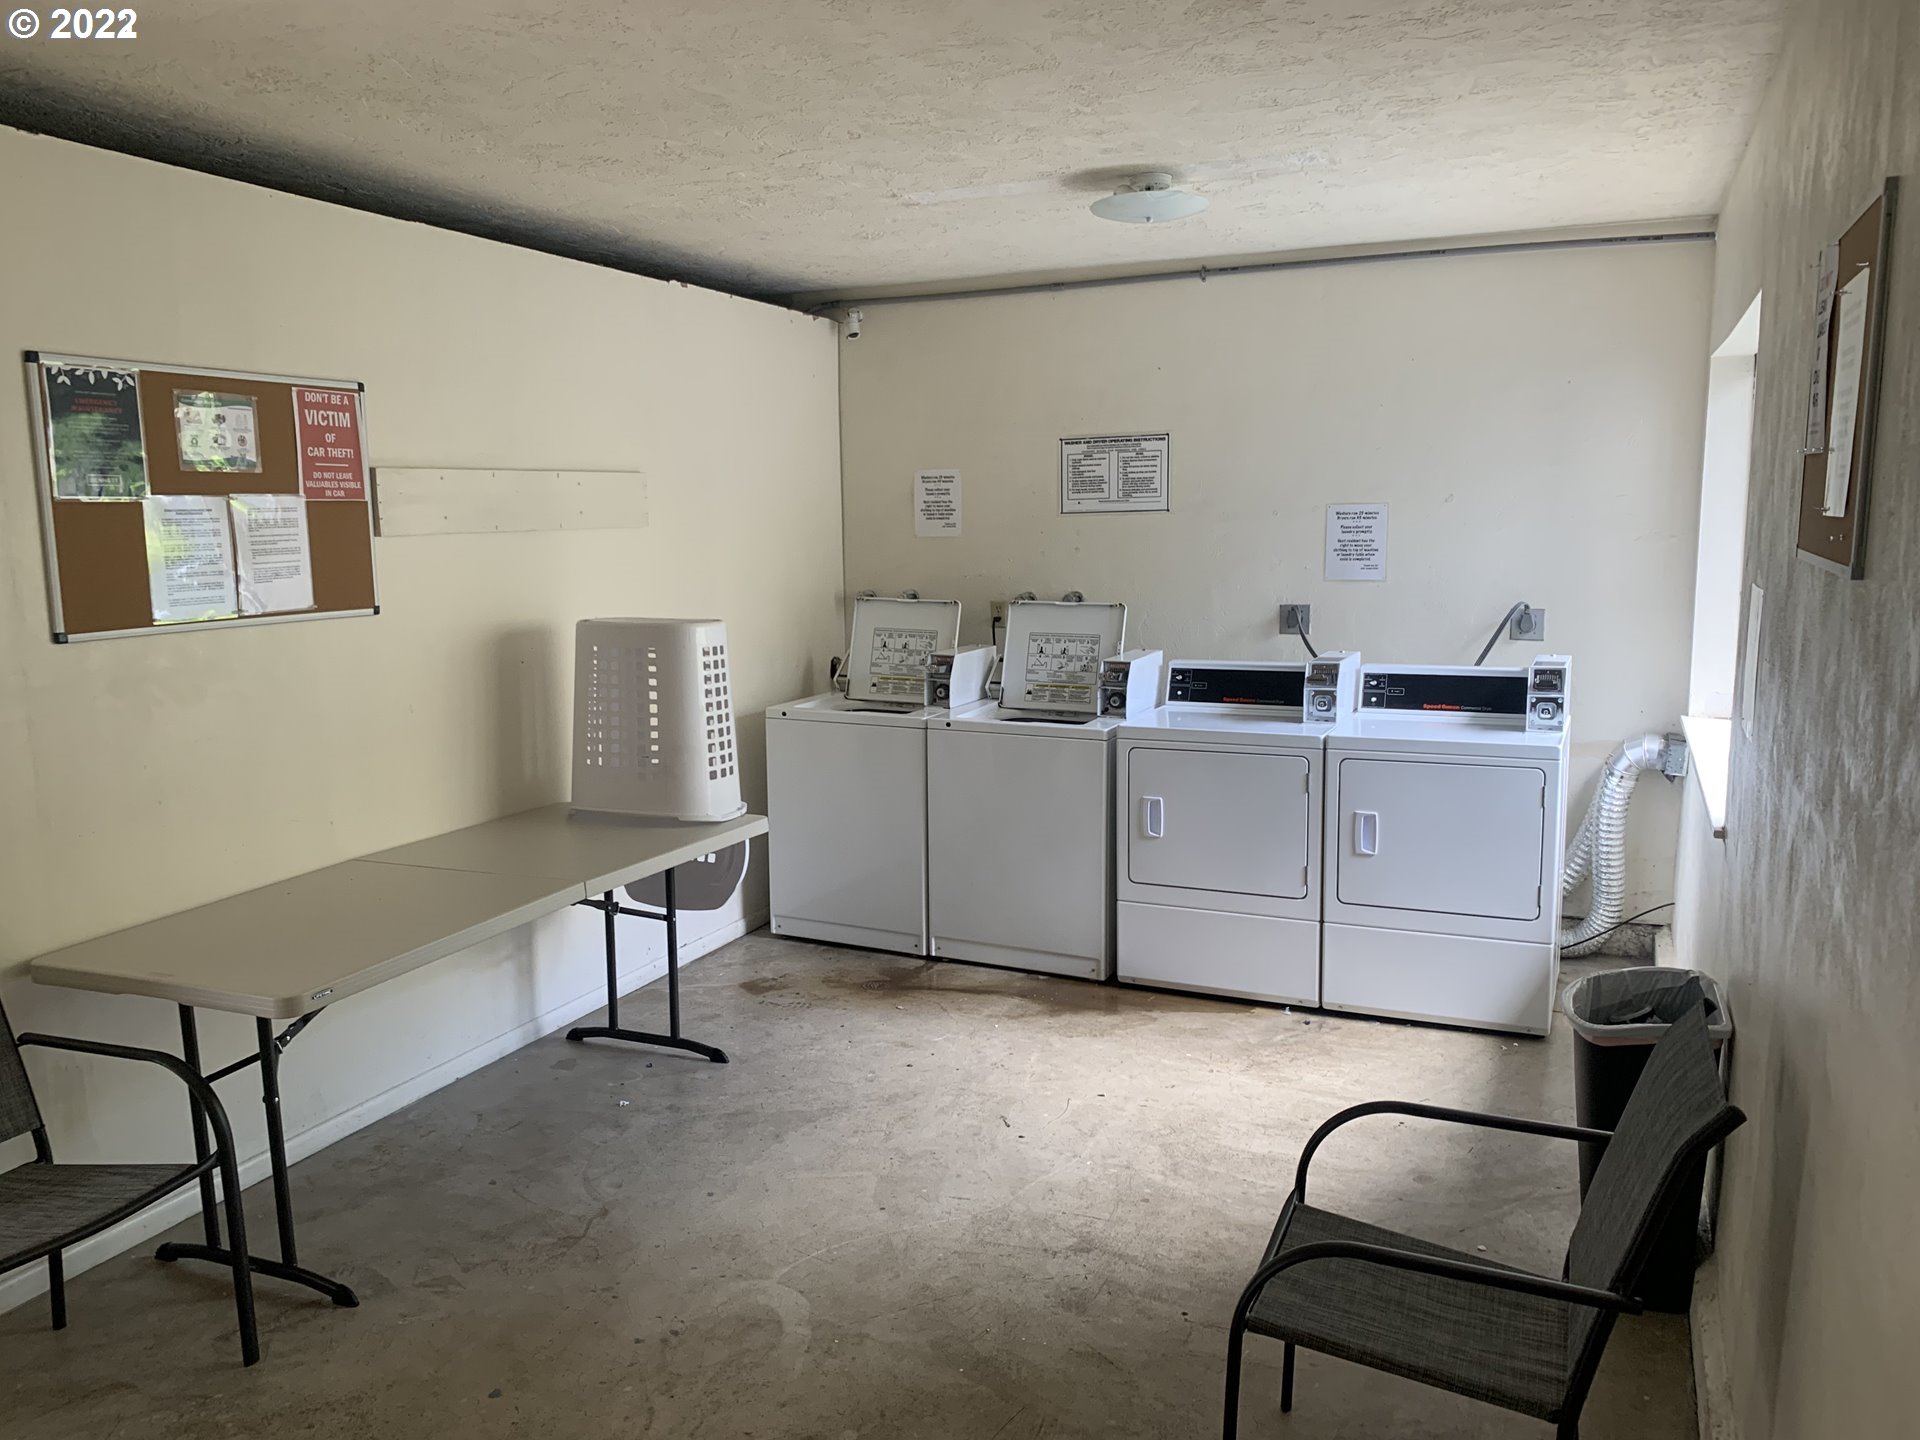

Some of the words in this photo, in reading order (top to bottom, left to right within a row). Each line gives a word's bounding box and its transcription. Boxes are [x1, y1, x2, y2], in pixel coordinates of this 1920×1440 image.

[304, 391, 328, 404] DON'T
[330, 394, 342, 405] BE
[343, 395, 349, 406] A
[304, 409, 351, 428] VICTIM
[325, 432, 336, 443] OF
[307, 446, 325, 457] CAR
[327, 447, 354, 459] THEFT!
[313, 471, 322, 479] DO
[336, 472, 353, 480] LEAVE
[305, 480, 339, 488] VALUABLES
[339, 481, 361, 489] VISIBLE
